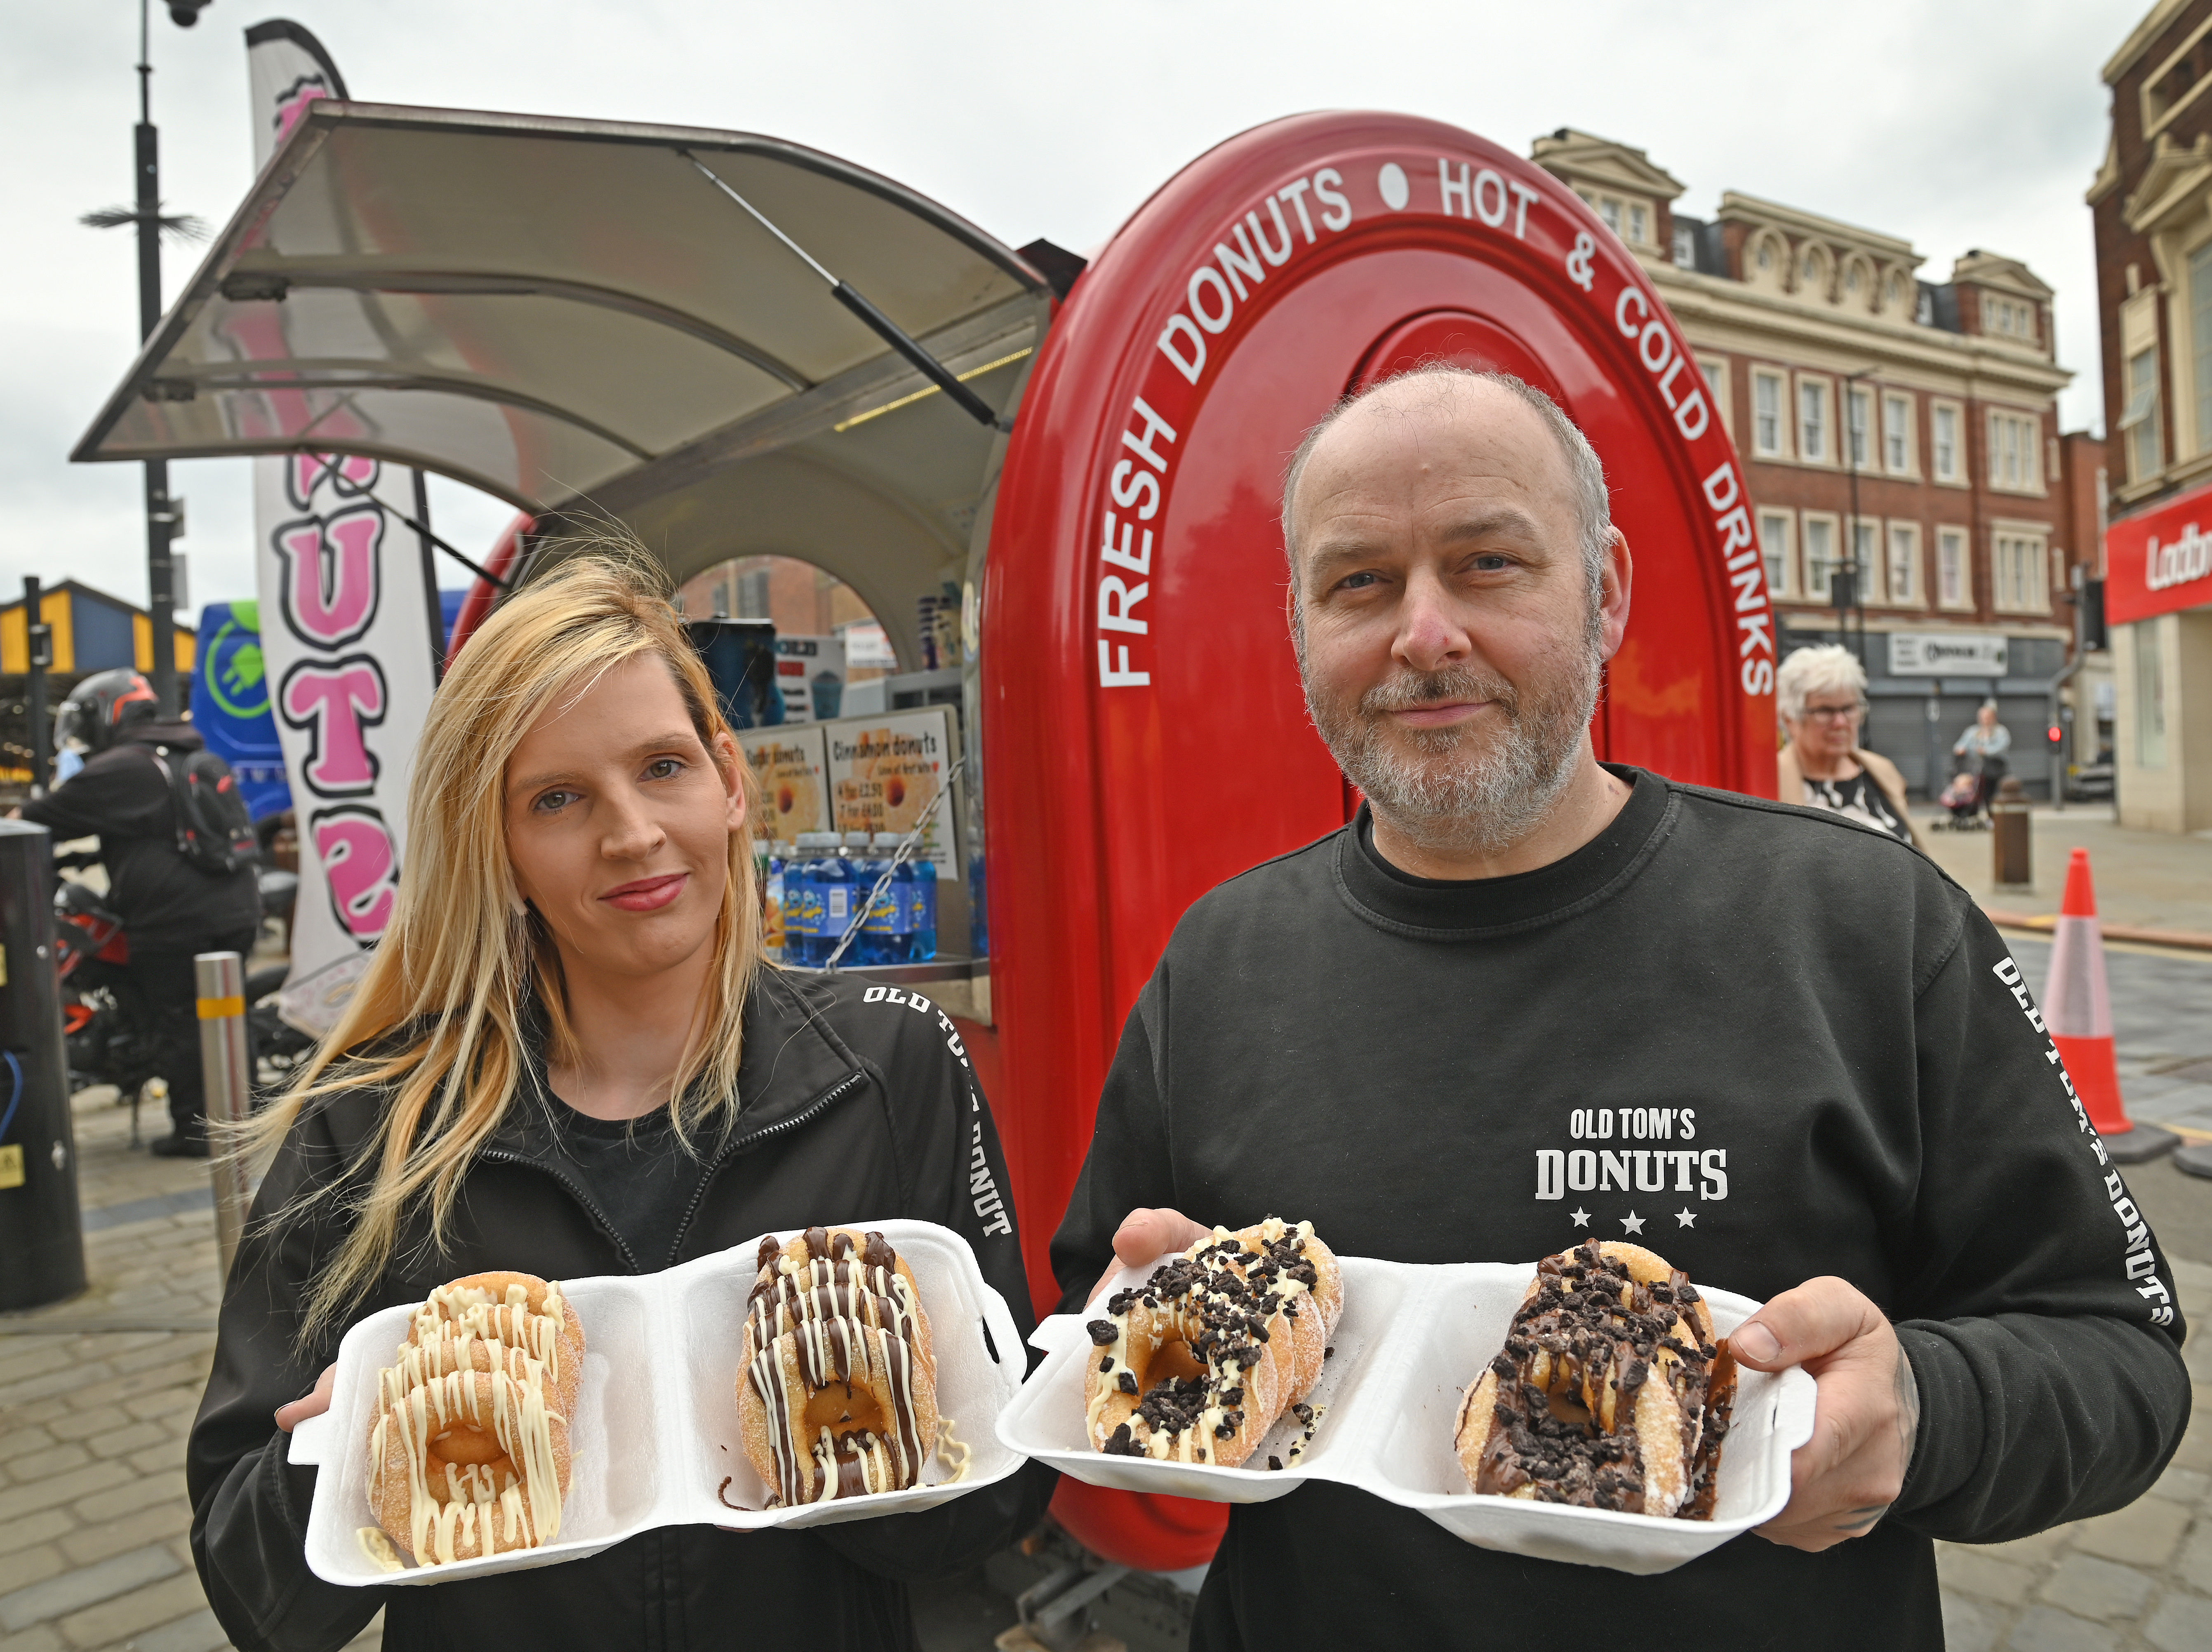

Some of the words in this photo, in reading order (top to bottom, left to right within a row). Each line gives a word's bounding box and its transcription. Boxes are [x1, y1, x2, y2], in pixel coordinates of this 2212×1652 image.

[1097, 395, 1177, 688] FRESH
[1156, 167, 1353, 385] DONUTS
[1438, 157, 1540, 240] HOT
[1566, 233, 1597, 291] &
[1616, 286, 1708, 440] COLD
[1703, 462, 1773, 696] DRINKS
[862, 986, 931, 1013] OLD
[1570, 1108, 1614, 1140] OLD
[1618, 1107, 1696, 1140] TOM'S
[1992, 956, 2045, 1034] OLD
[2104, 1168, 2174, 1327] DONUTS
[1534, 1149, 1728, 1201] DONUTS
